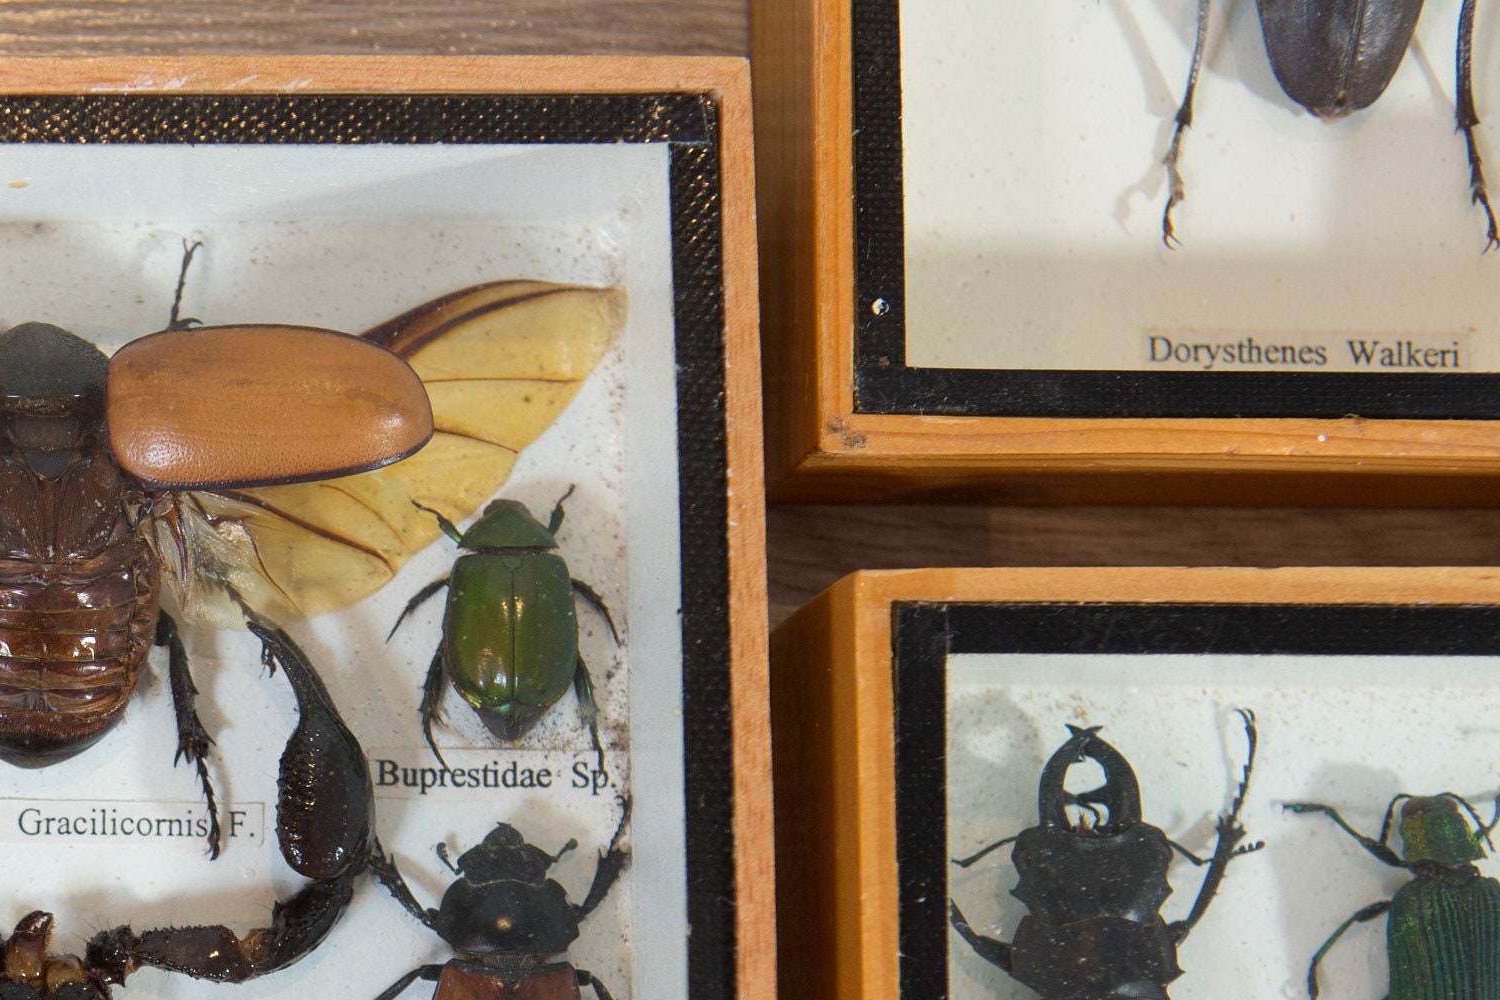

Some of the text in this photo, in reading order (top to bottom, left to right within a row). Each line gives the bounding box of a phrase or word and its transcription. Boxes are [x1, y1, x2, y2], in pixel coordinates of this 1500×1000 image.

[1149, 336, 1461, 370] Dorysthenes Walkeri
[376, 759, 617, 795] Buprestidae Sp.
[228, 811, 256, 838] F.
